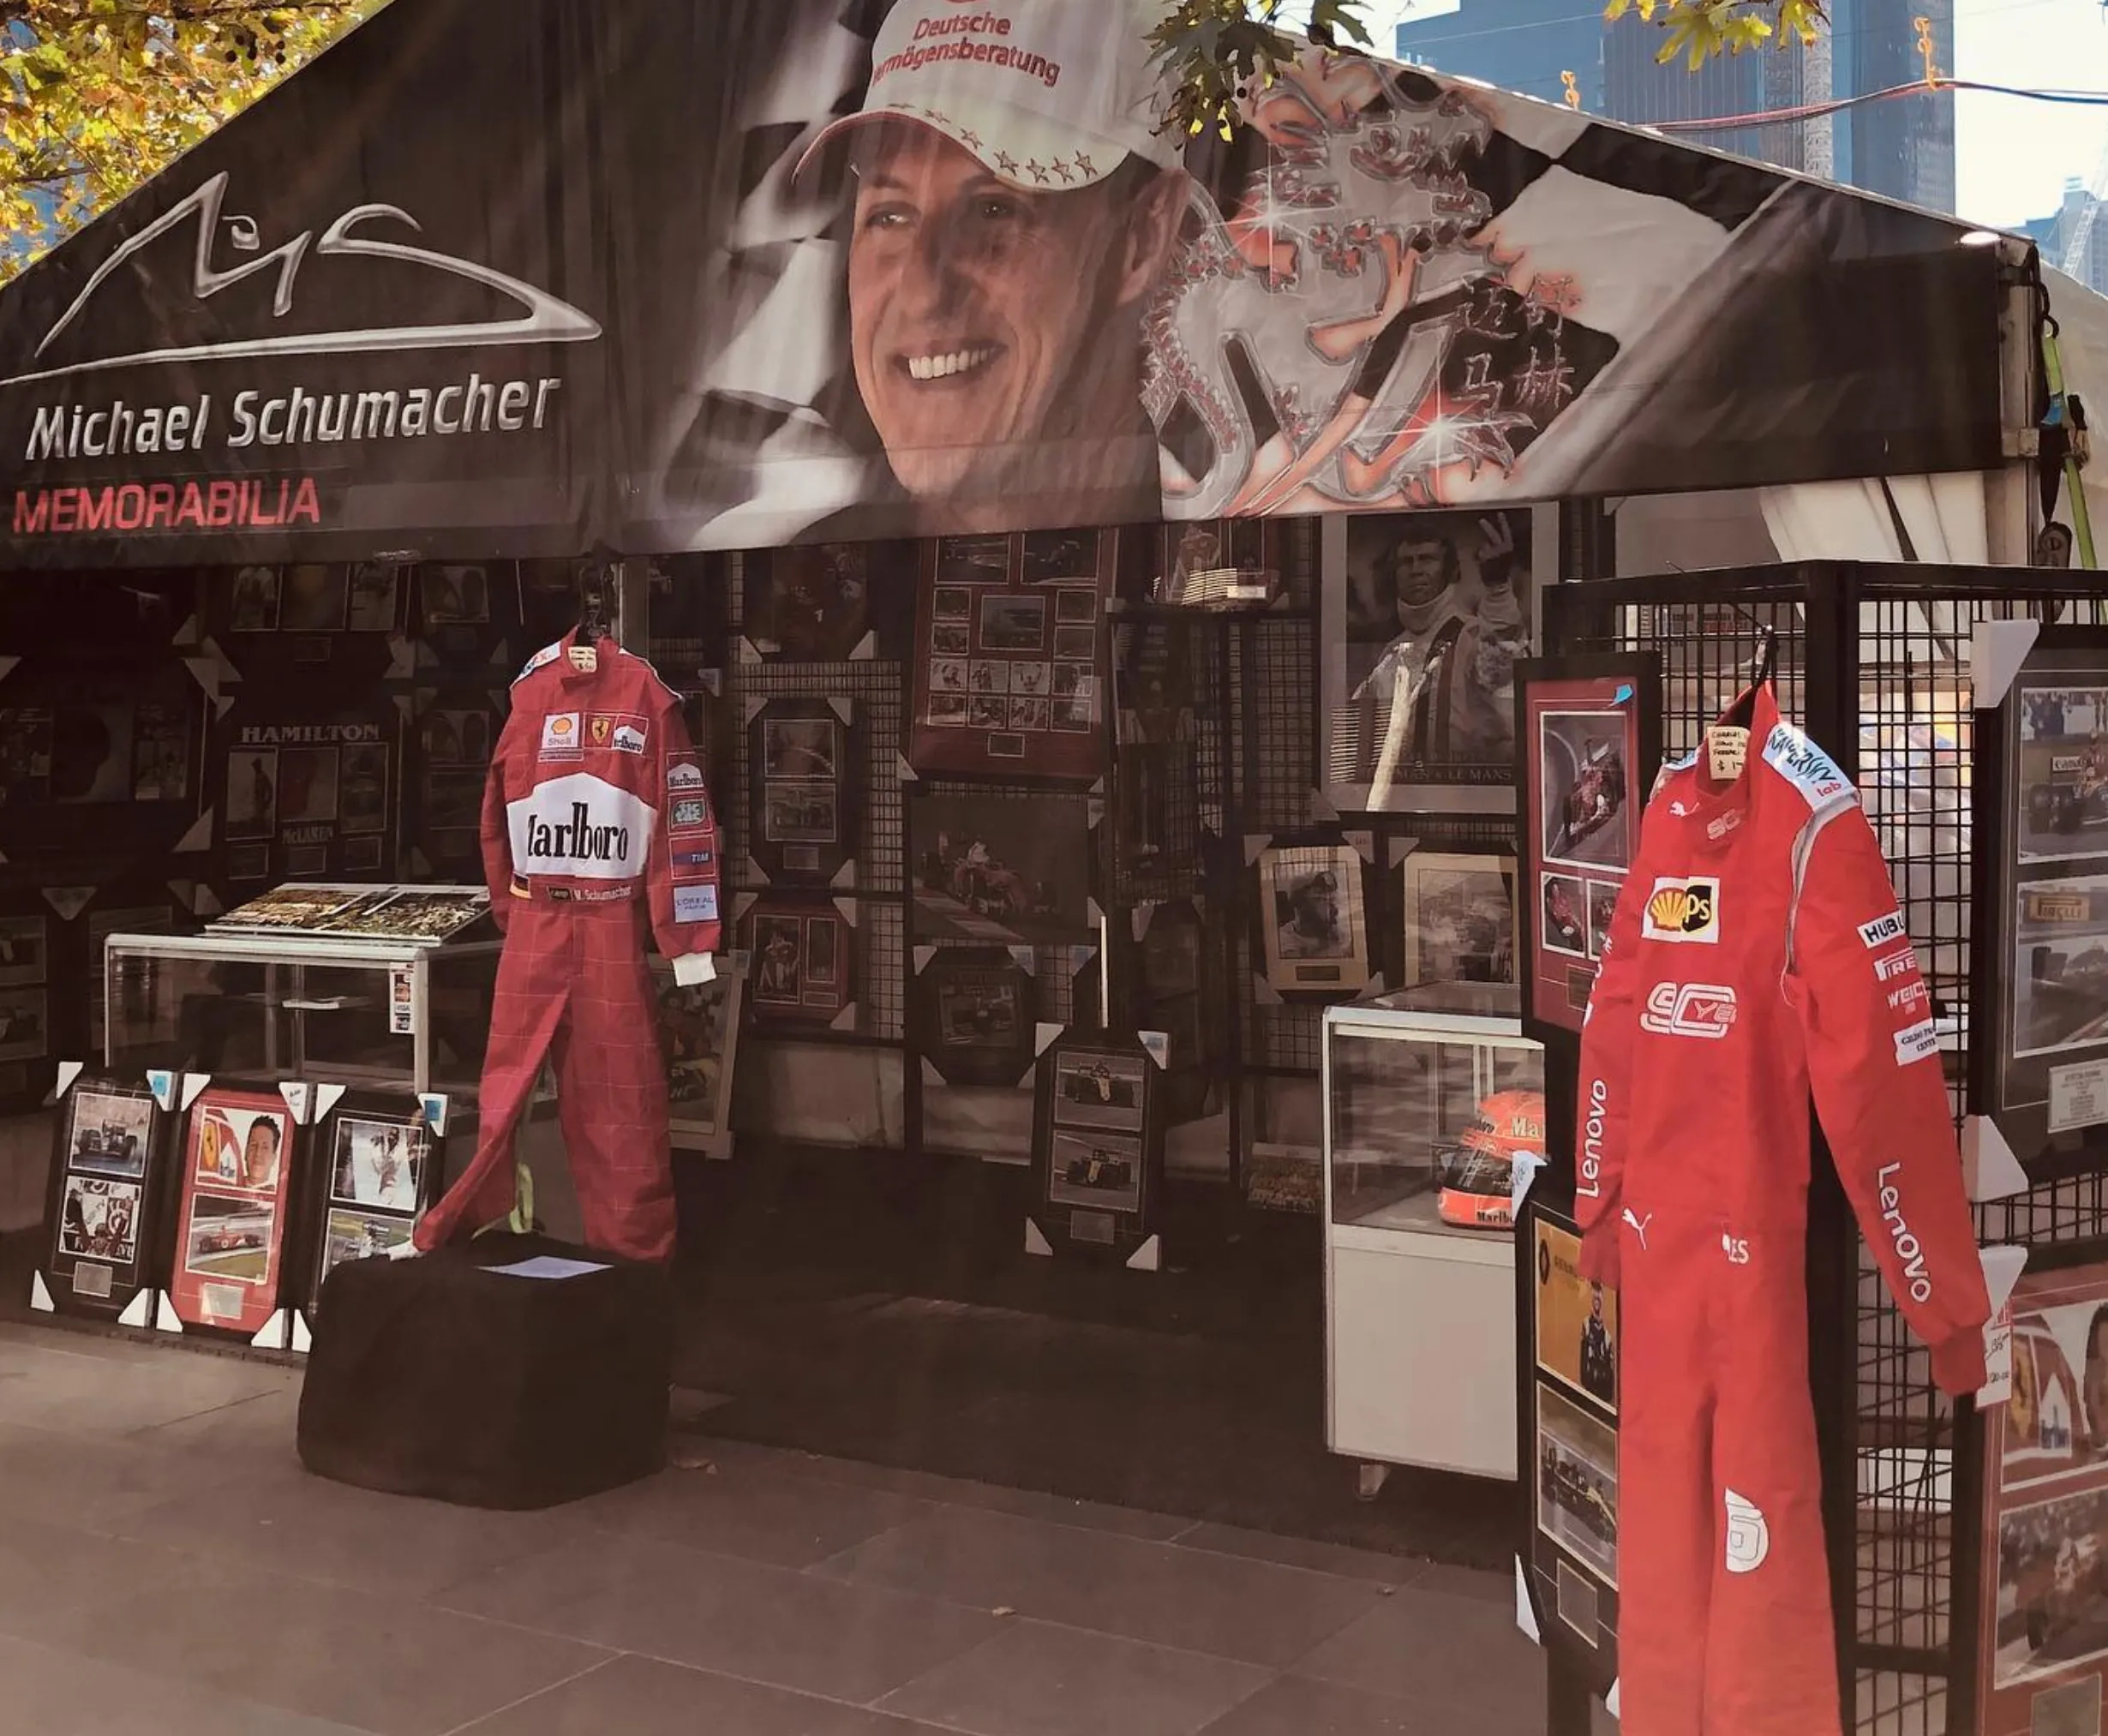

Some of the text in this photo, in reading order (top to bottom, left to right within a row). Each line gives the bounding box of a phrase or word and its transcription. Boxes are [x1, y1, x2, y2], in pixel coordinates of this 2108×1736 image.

[913, 12, 1011, 40] Deutsche
[871, 37, 1061, 87] ermögensberatung
[25, 374, 561, 460] Michael Schumacher
[13, 477, 320, 534] MEMORABILIA
[242, 725, 380, 743] HAMILTON
[548, 737, 572, 746] Shell
[1469, 769, 1512, 781] MANS
[1817, 781, 1842, 797] lab
[1511, 1116, 1542, 1139] Ma
[1576, 1080, 1608, 1198] Lenovo
[1877, 1161, 1931, 1303] Lenovo
